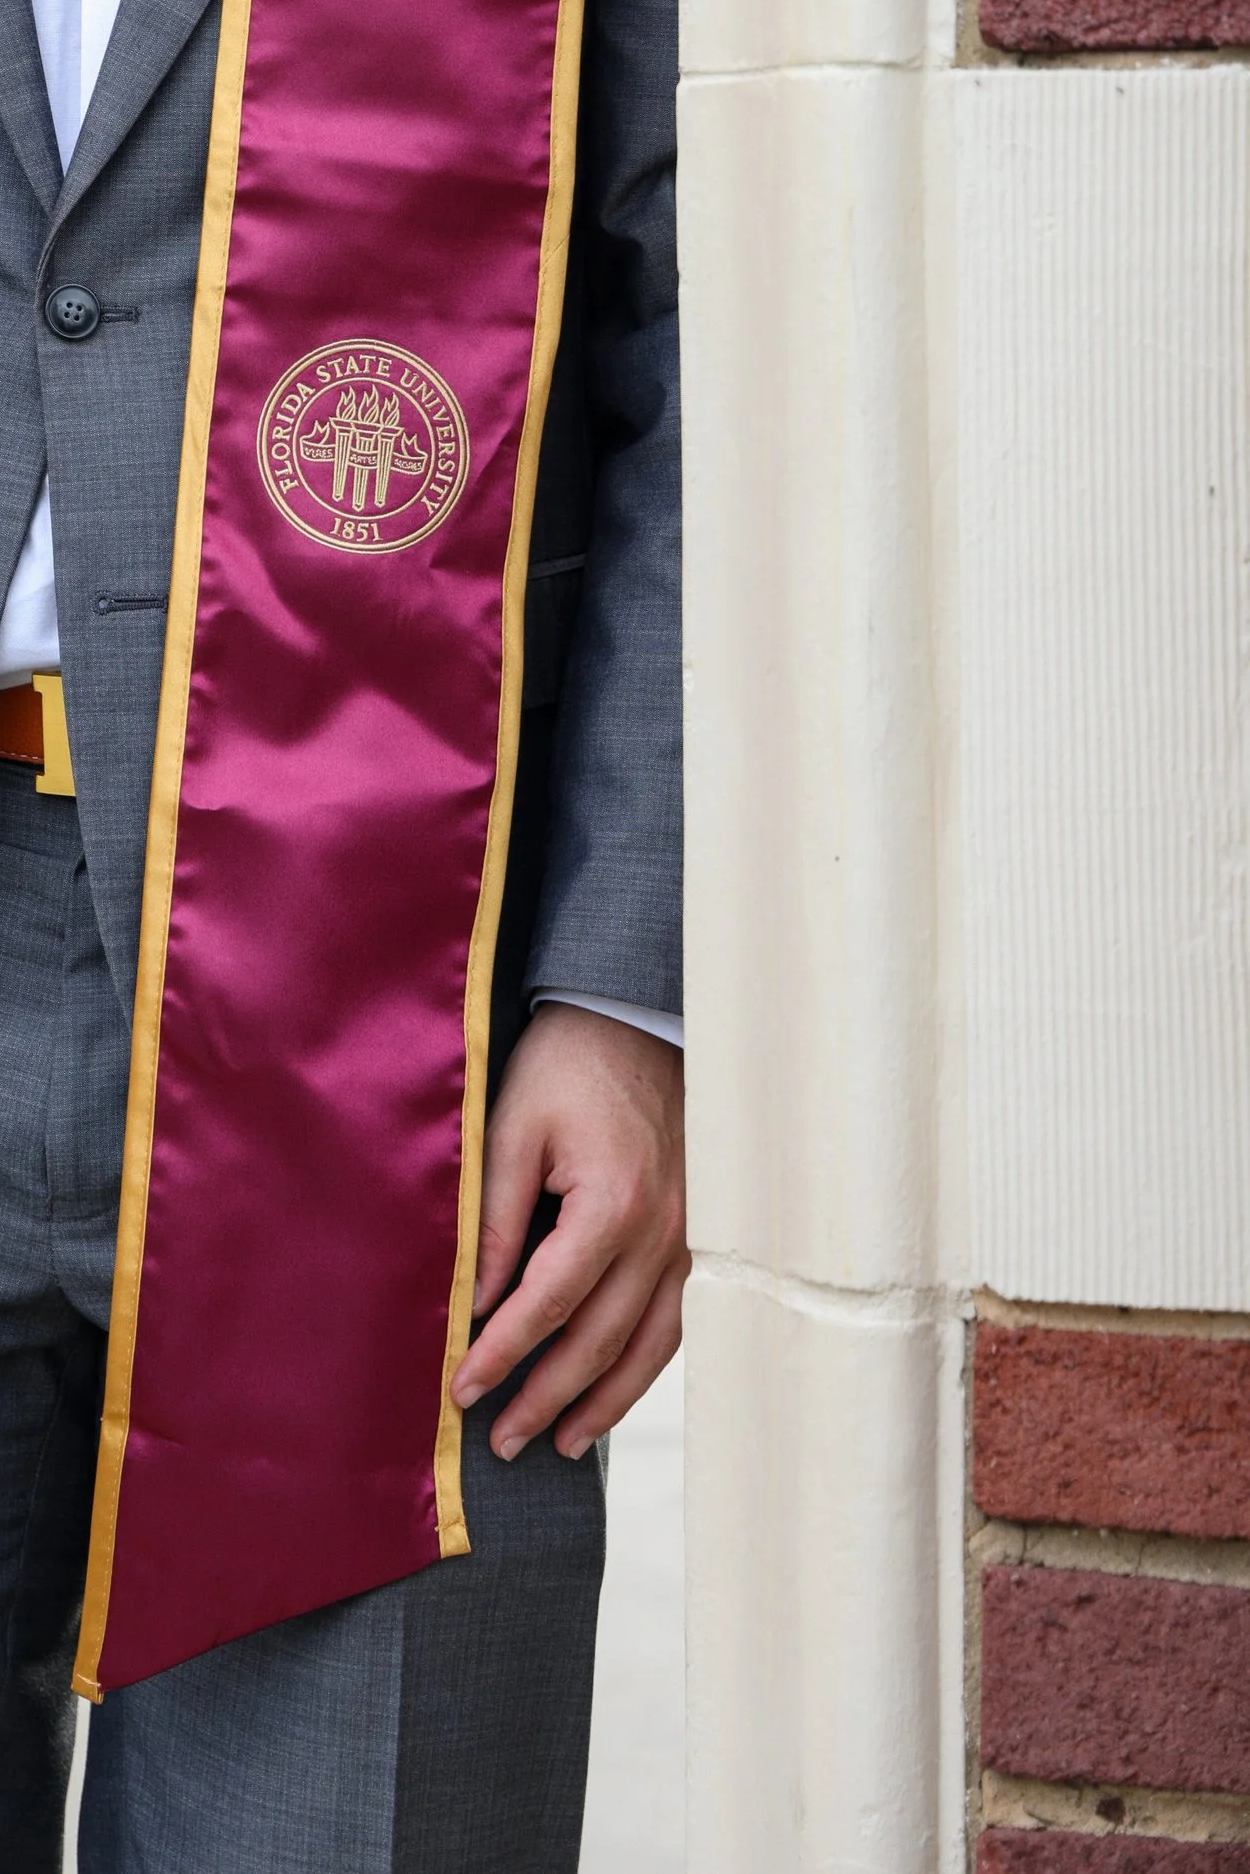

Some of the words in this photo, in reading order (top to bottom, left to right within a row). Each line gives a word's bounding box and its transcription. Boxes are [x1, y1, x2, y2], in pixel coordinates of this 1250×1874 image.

[271, 382, 316, 494] FLORIDA
[316, 355, 392, 383] STATE
[401, 368, 456, 516] UNIVERSITY
[330, 518, 383, 542] 1851
